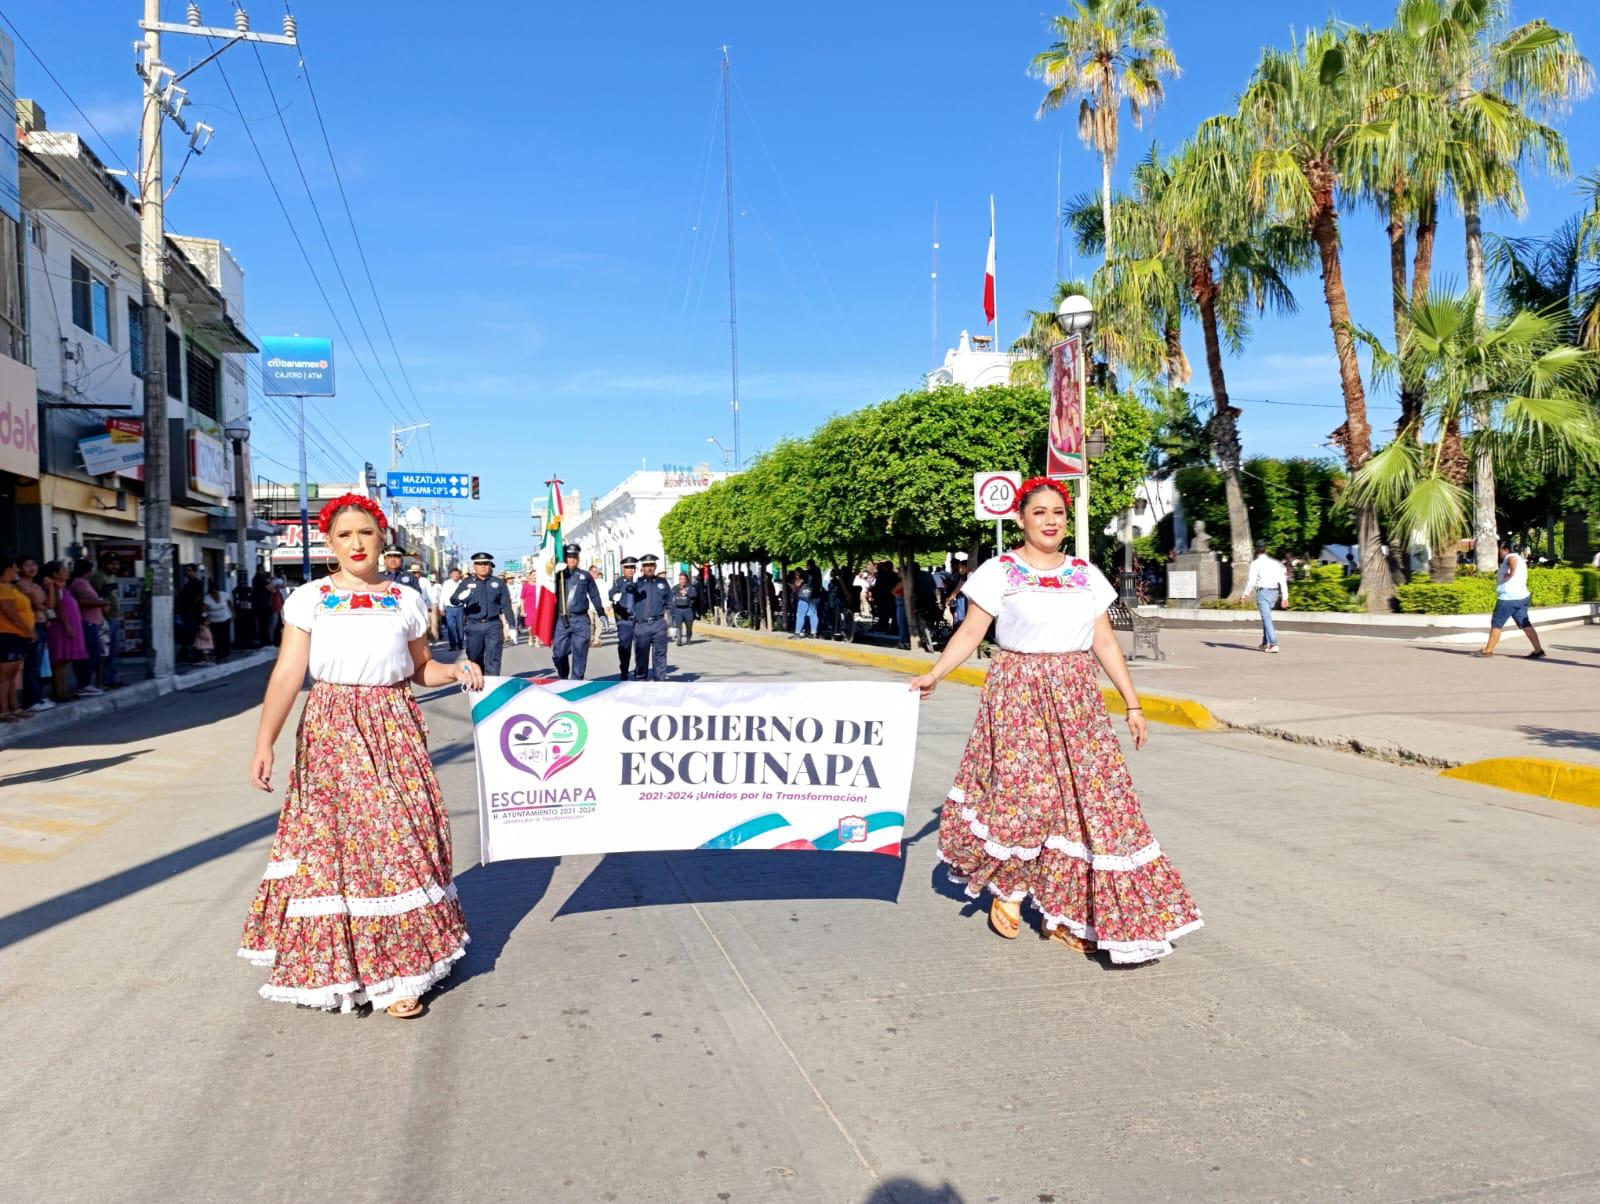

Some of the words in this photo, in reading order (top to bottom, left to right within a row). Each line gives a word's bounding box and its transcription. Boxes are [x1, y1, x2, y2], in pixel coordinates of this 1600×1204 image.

[267, 358, 320, 369] citibanamex
[275, 371, 302, 379] CAJERO
[402, 475, 447, 484] MAZATLAN
[990, 484, 1009, 501] 20
[622, 714, 823, 743] GOBIERNO
[832, 719, 883, 746] DE
[618, 751, 881, 788] ESCUINAPA
[491, 787, 597, 808] ESCUINAPA
[639, 791, 693, 800] 2021-2024
[696, 790, 738, 800] ¡Unidos
[740, 792, 759, 800] por
[762, 791, 773, 800] la
[776, 791, 868, 803] Transformación!
[502, 809, 558, 819] AYUNTAMIENTO
